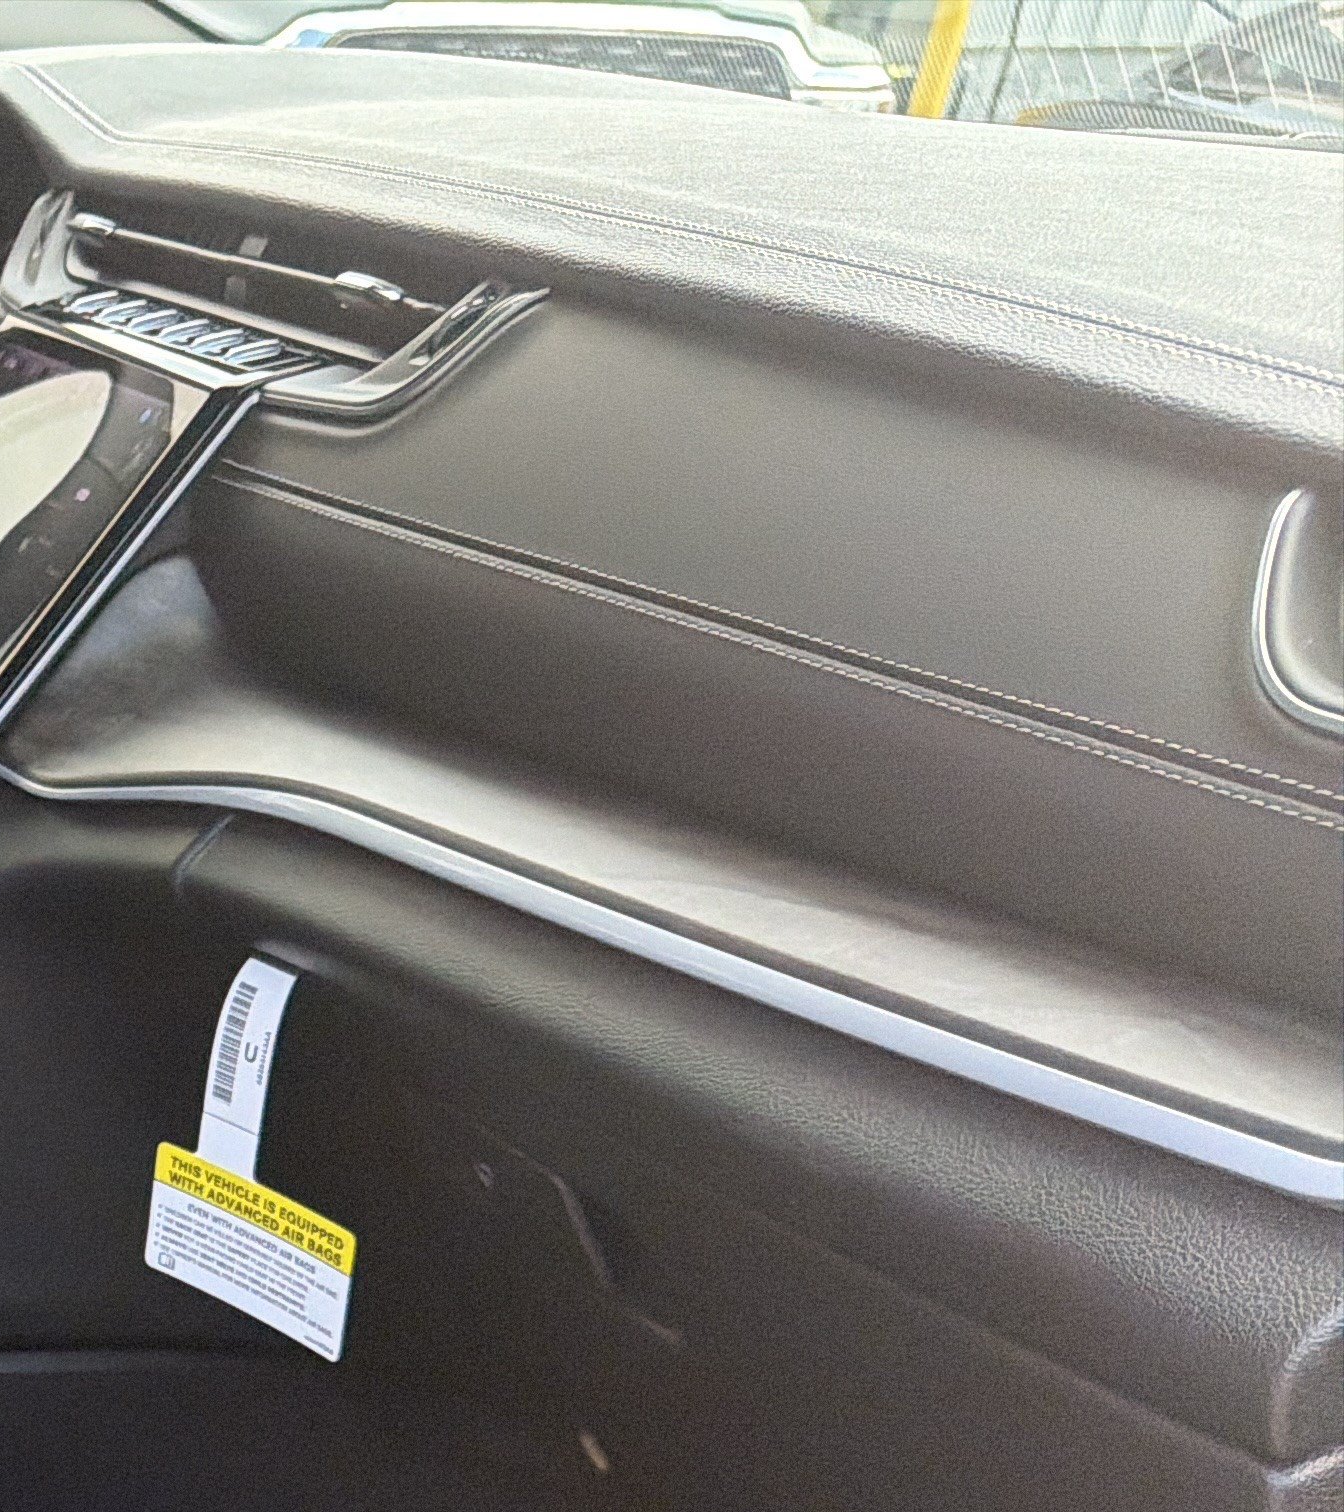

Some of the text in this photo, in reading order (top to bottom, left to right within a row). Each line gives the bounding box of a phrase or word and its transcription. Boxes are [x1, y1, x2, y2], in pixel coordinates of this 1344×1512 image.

[245, 1042, 258, 1063] C
[169, 1172, 342, 1267] WITH ADVANCED AIR BAGS
[170, 1155, 344, 1251] THIS VEHICLE IS EQUIPPED
[187, 1203, 210, 1220] EVEN
[211, 1213, 233, 1230] WITH
[233, 1223, 278, 1254] ADVANCED
